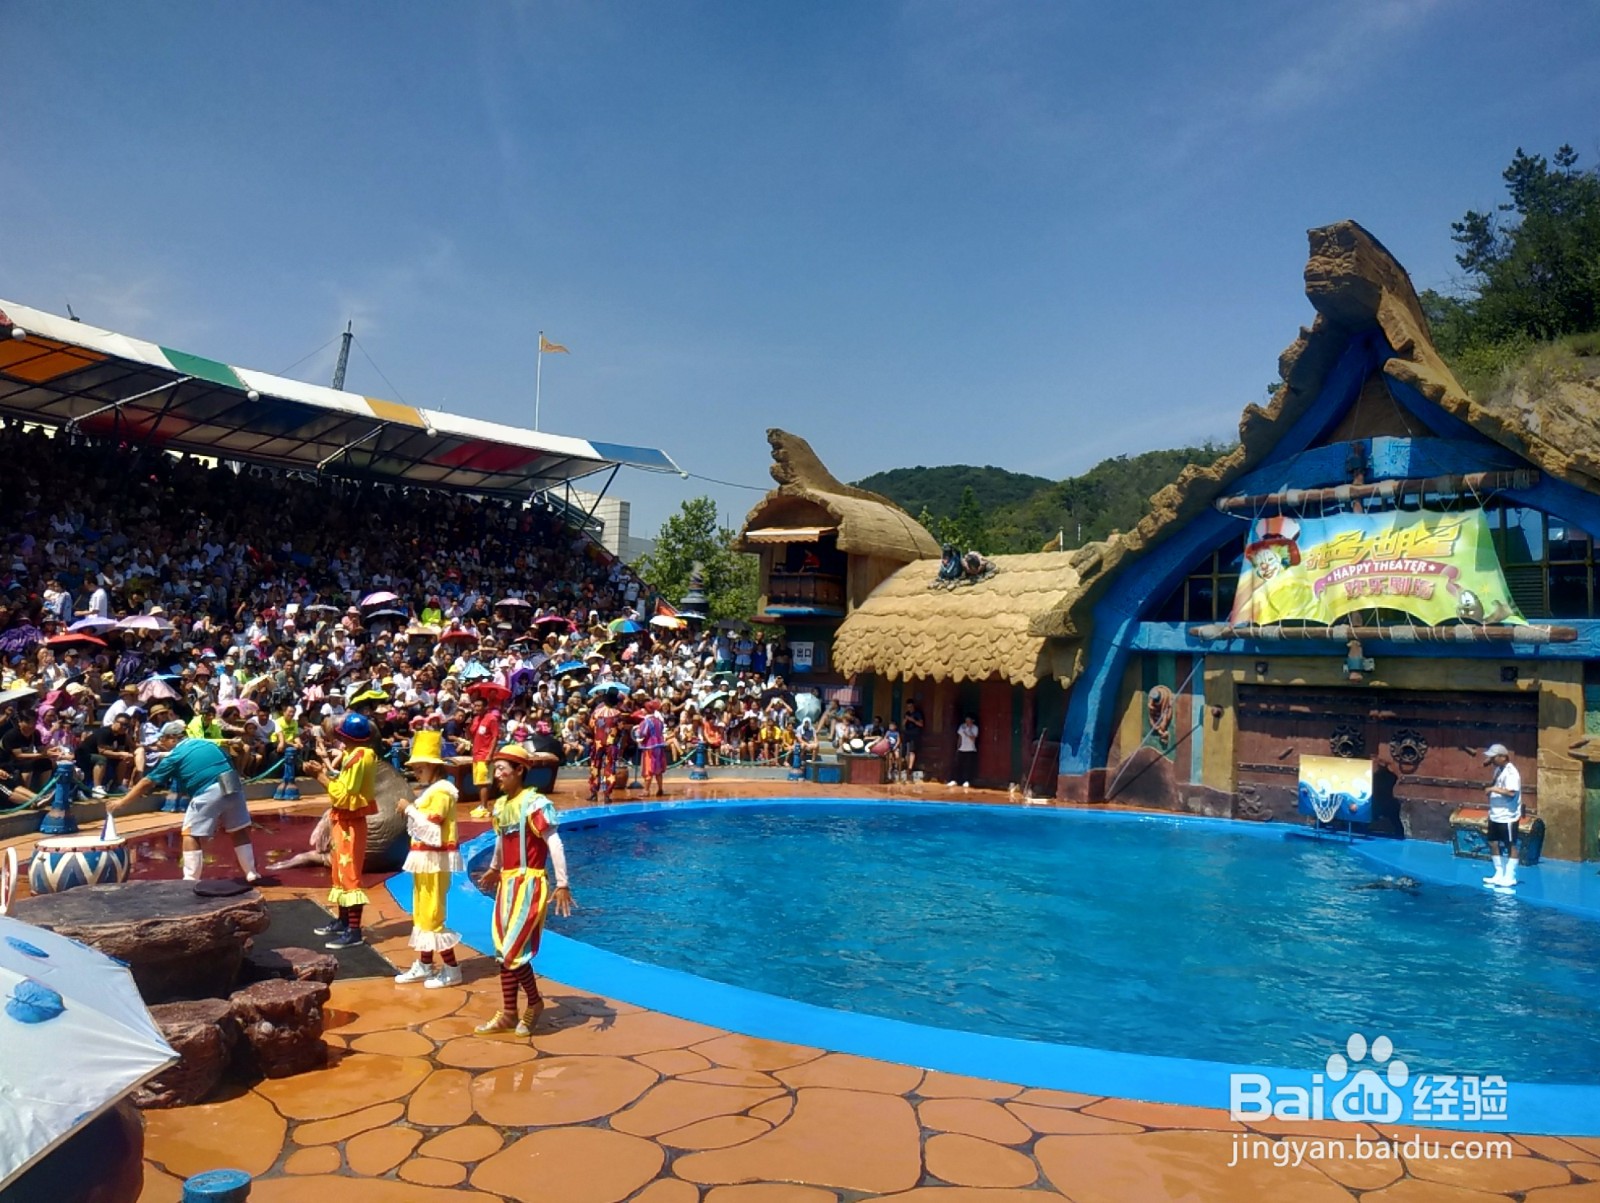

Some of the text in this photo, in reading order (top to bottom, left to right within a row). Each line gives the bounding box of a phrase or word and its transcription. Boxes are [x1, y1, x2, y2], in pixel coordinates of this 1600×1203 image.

[1332, 559, 1427, 582] HAPPY THEATER
[1344, 576, 1435, 600] 欢乐剧场
[796, 647, 811, 658] 出口
